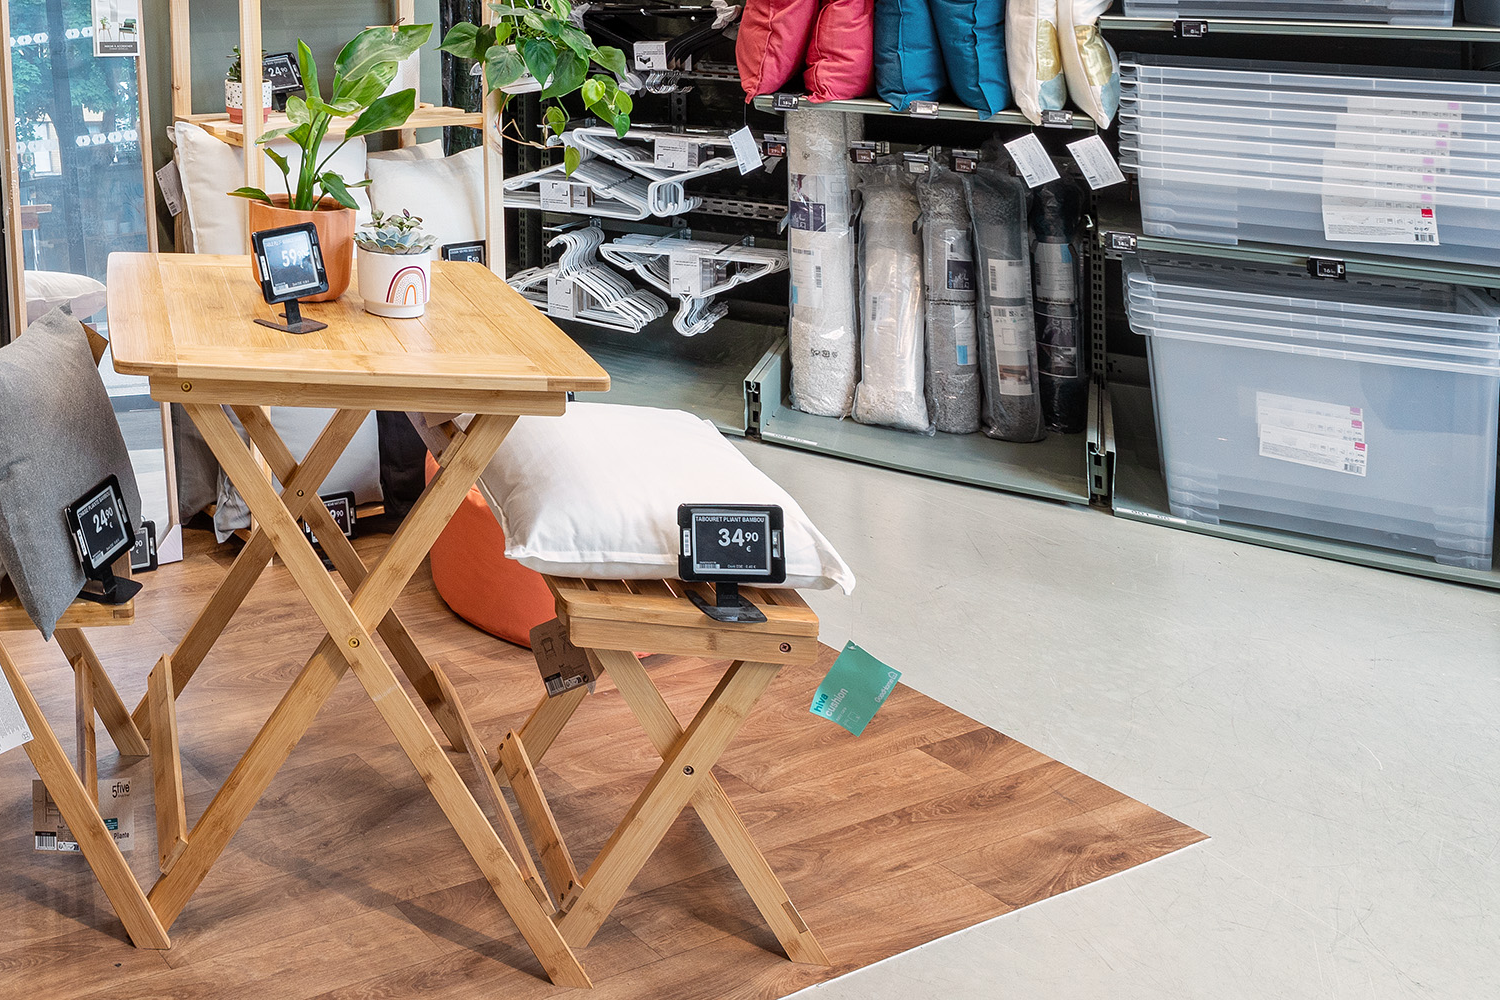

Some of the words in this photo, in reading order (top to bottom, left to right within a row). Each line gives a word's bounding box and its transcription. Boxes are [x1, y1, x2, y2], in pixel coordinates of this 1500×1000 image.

[813, 693, 829, 713] hiva
[825, 688, 849, 717] cushion
[874, 678, 895, 703] GoodHome
